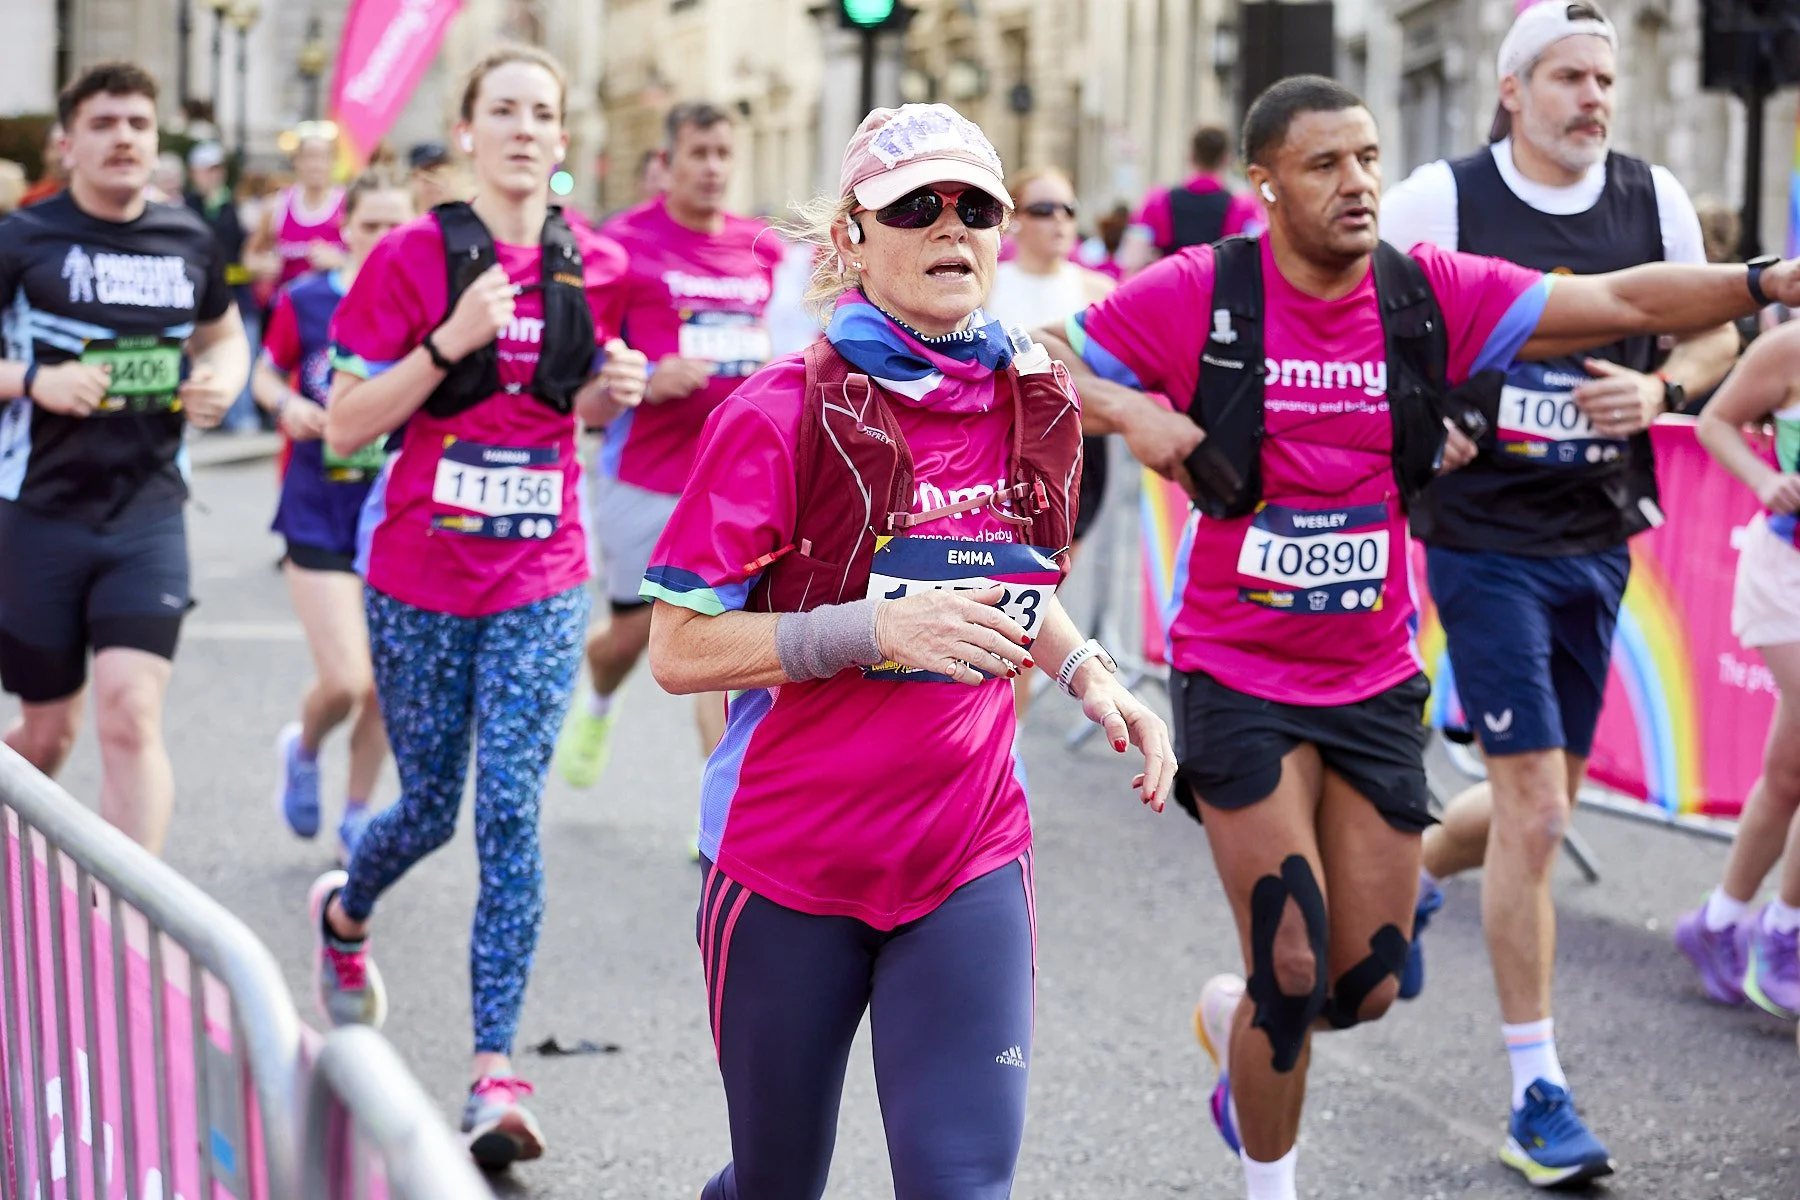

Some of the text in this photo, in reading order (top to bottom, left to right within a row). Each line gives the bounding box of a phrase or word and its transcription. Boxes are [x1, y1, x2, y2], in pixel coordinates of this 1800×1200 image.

[1319, 400, 1344, 413] and
[1344, 400, 1377, 414] baby
[451, 472, 553, 507] 11156
[1292, 513, 1348, 529] WESLEY
[947, 549, 995, 567] EMMA
[1258, 538, 1378, 576] 10890
[995, 1055, 1026, 1069] adidas
